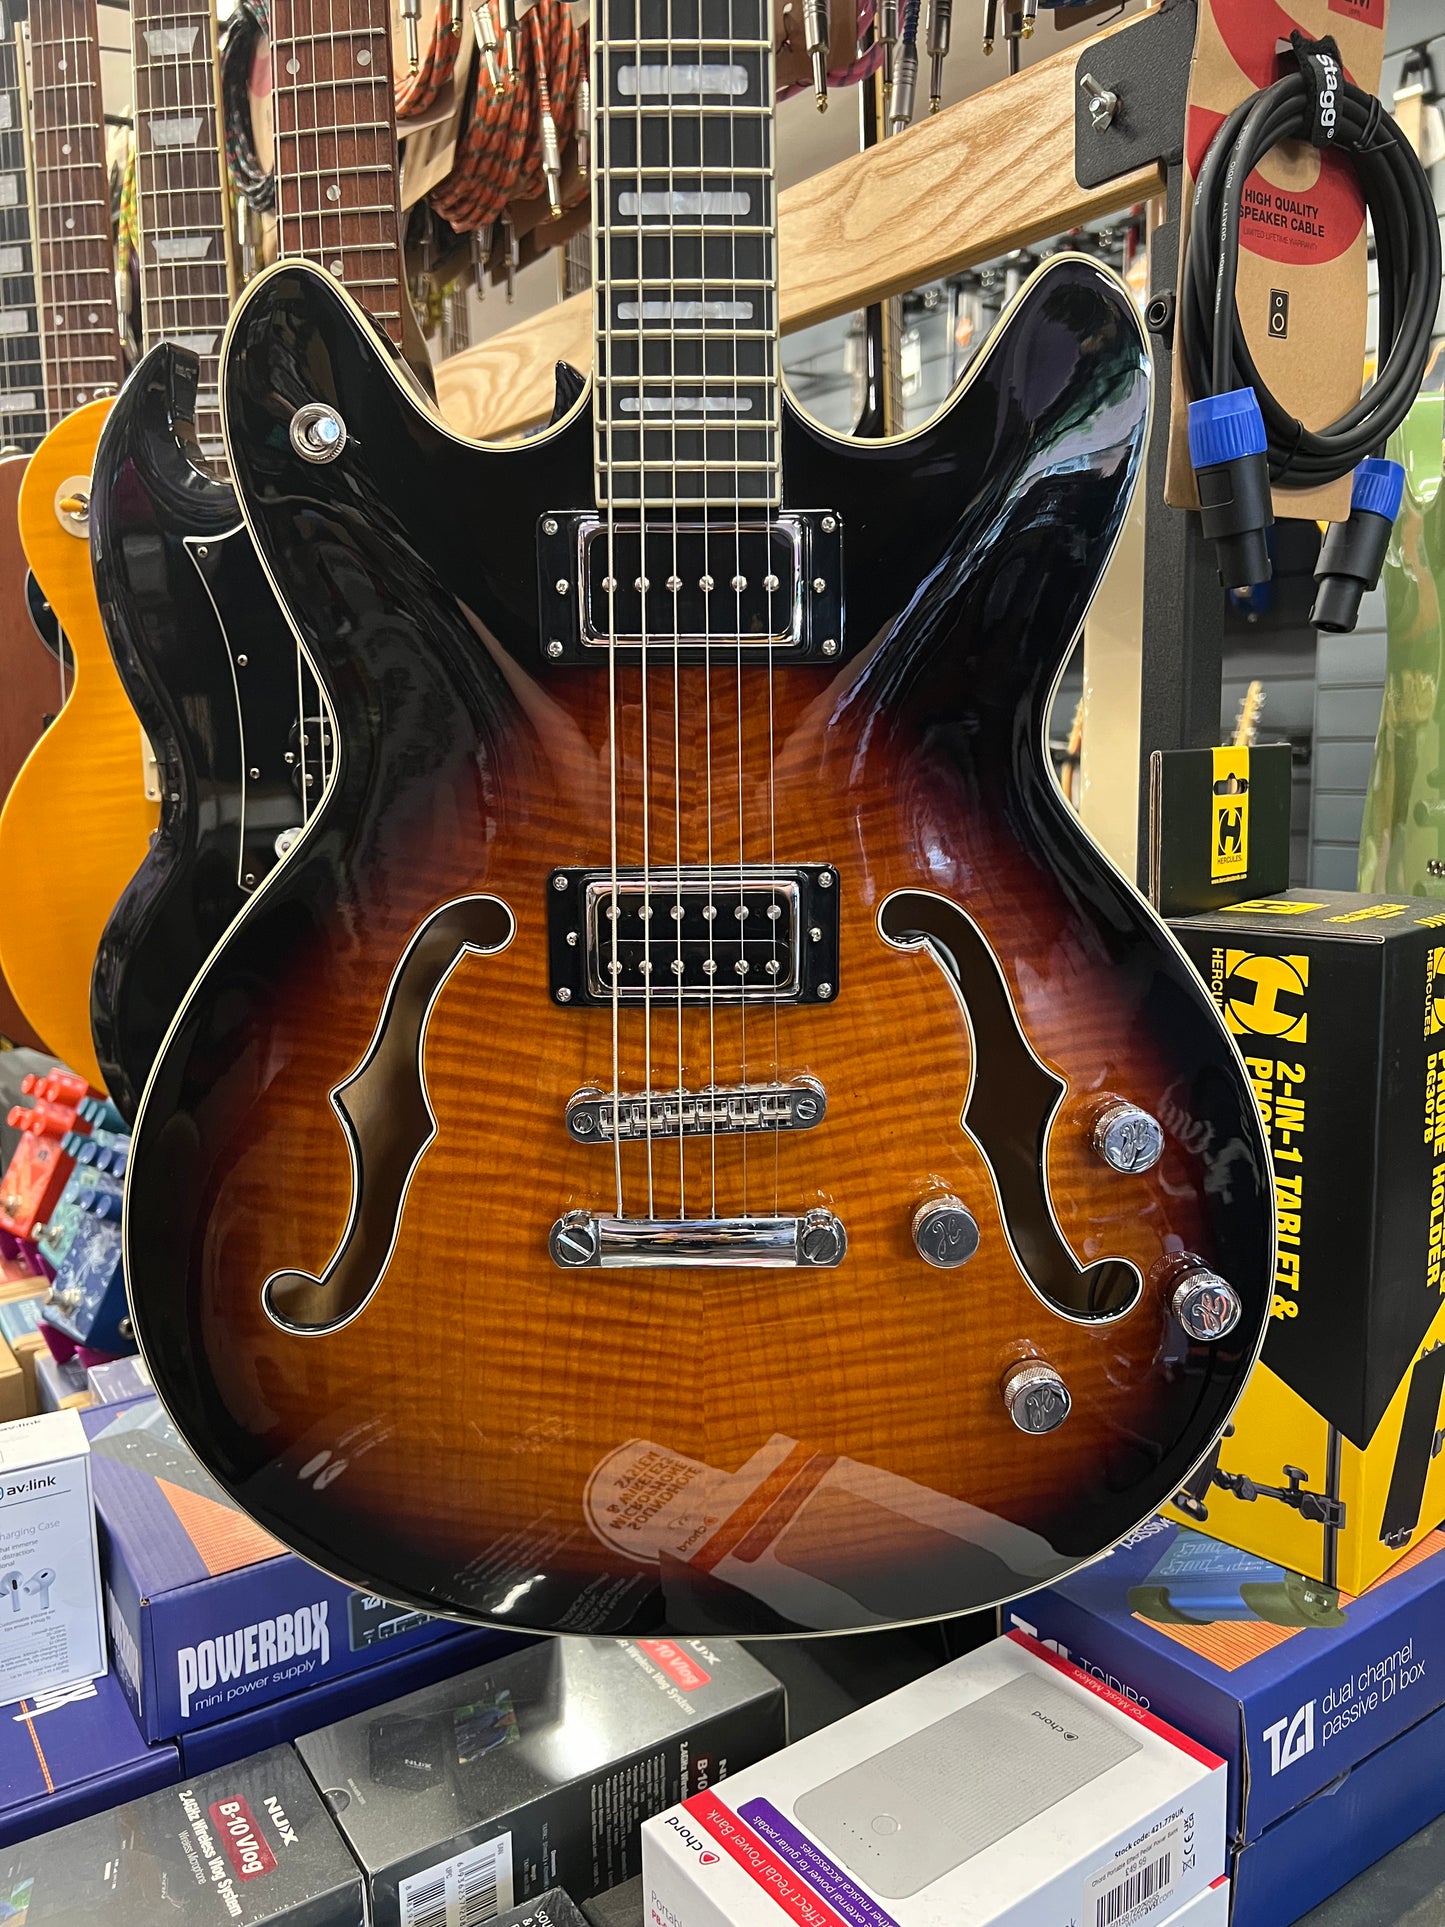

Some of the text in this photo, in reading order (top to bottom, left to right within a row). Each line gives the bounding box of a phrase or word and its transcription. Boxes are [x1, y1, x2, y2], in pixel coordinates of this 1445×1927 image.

[1226, 161, 1237, 189] AUDIO
[1221, 201, 1229, 241] QUALITY
[1240, 204, 1325, 238] SPEAKER CABLE
[1245, 188, 1319, 219] HIGH QUALITY
[1218, 252, 1226, 277] HIGH
[1274, 1059, 1306, 1163] 2-IN-1
[1424, 1052, 1438, 1144] DG307B
[1426, 1162, 1445, 1288] HOLDER
[1270, 1294, 1299, 1320] &
[7, 1475, 57, 1496] av:link
[11, 1539, 39, 1551] immerse
[37, 1519, 61, 1532] Case
[178, 1600, 330, 1718] POWERBOX
[669, 1655, 700, 1685] Vlog
[1322, 1637, 1413, 1714] dual channel
[195, 1659, 316, 1711] mini power supply
[625, 1645, 696, 1715] Wireless Vlog System
[1072, 1670, 1147, 1720] For Music Makers
[1031, 1710, 1064, 1733] chord
[1322, 1692, 1378, 1747] passive
[1382, 1673, 1396, 1703] DI
[1400, 1660, 1426, 1691] box
[697, 1758, 708, 1790] B-10
[219, 1801, 264, 1874] B-10 Vlog
[263, 1796, 299, 1847] NUX
[664, 1816, 703, 1851] chord
[1115, 1807, 1185, 1858] Stock code: 421.779UK
[178, 1789, 242, 1917] 2.4GHz Wireless Vlog System
[187, 1849, 207, 1885] Microphone
[445, 1866, 453, 1880] UPC
[706, 1809, 827, 1927] Effect Pedal Power Bank
[753, 1815, 866, 1923] external power for guitar pedals
[800, 1843, 843, 1884] accessories
[841, 1881, 874, 1912] musical
[1091, 1873, 1106, 1887] Chord
